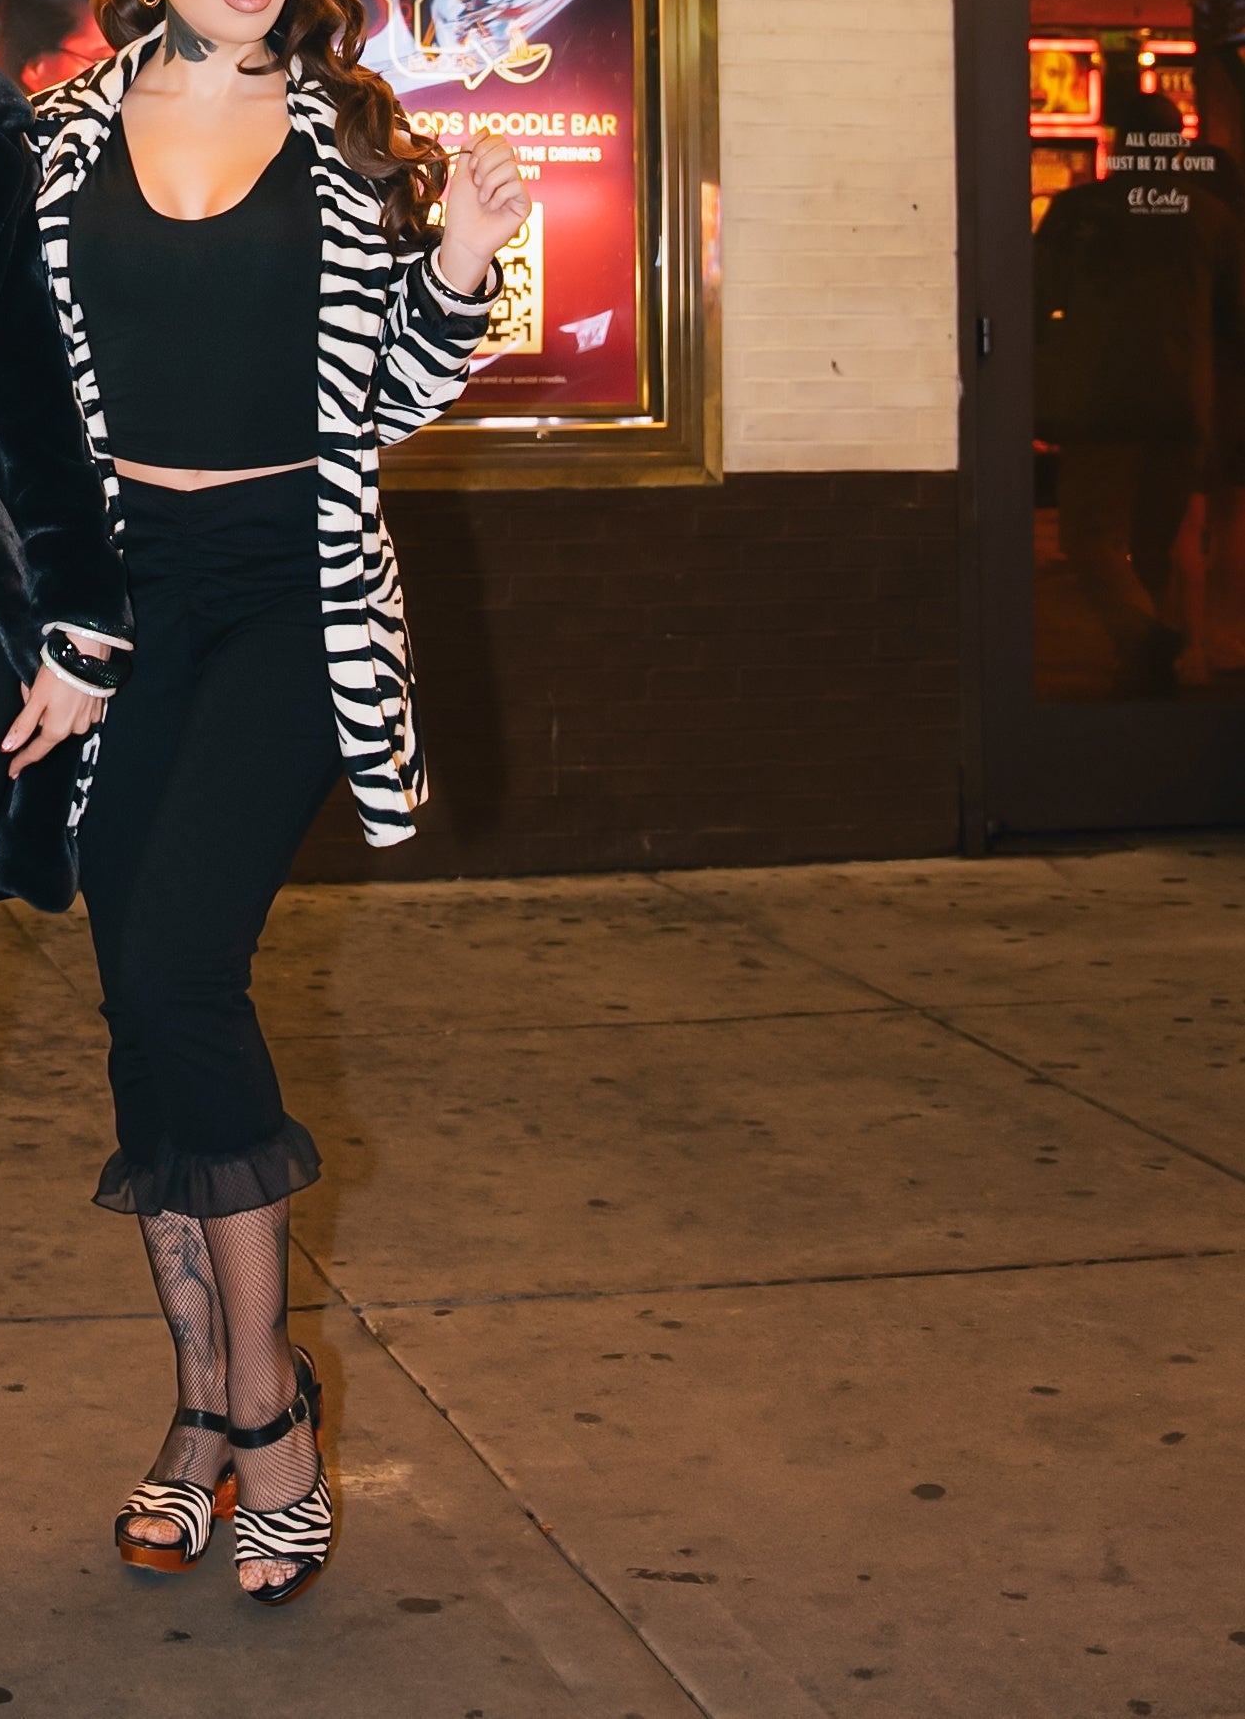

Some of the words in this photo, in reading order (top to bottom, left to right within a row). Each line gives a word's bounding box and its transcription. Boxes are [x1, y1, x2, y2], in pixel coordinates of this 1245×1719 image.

[469, 112, 565, 137] NOODLE
[570, 113, 618, 136] BAR
[1125, 132, 1146, 148] ALL
[518, 145, 547, 162] THE
[548, 145, 602, 162] DRINKS
[1137, 155, 1151, 171] BE
[1154, 155, 1167, 171] 21
[1183, 155, 1216, 171] OVER
[1127, 186, 1144, 206] El
